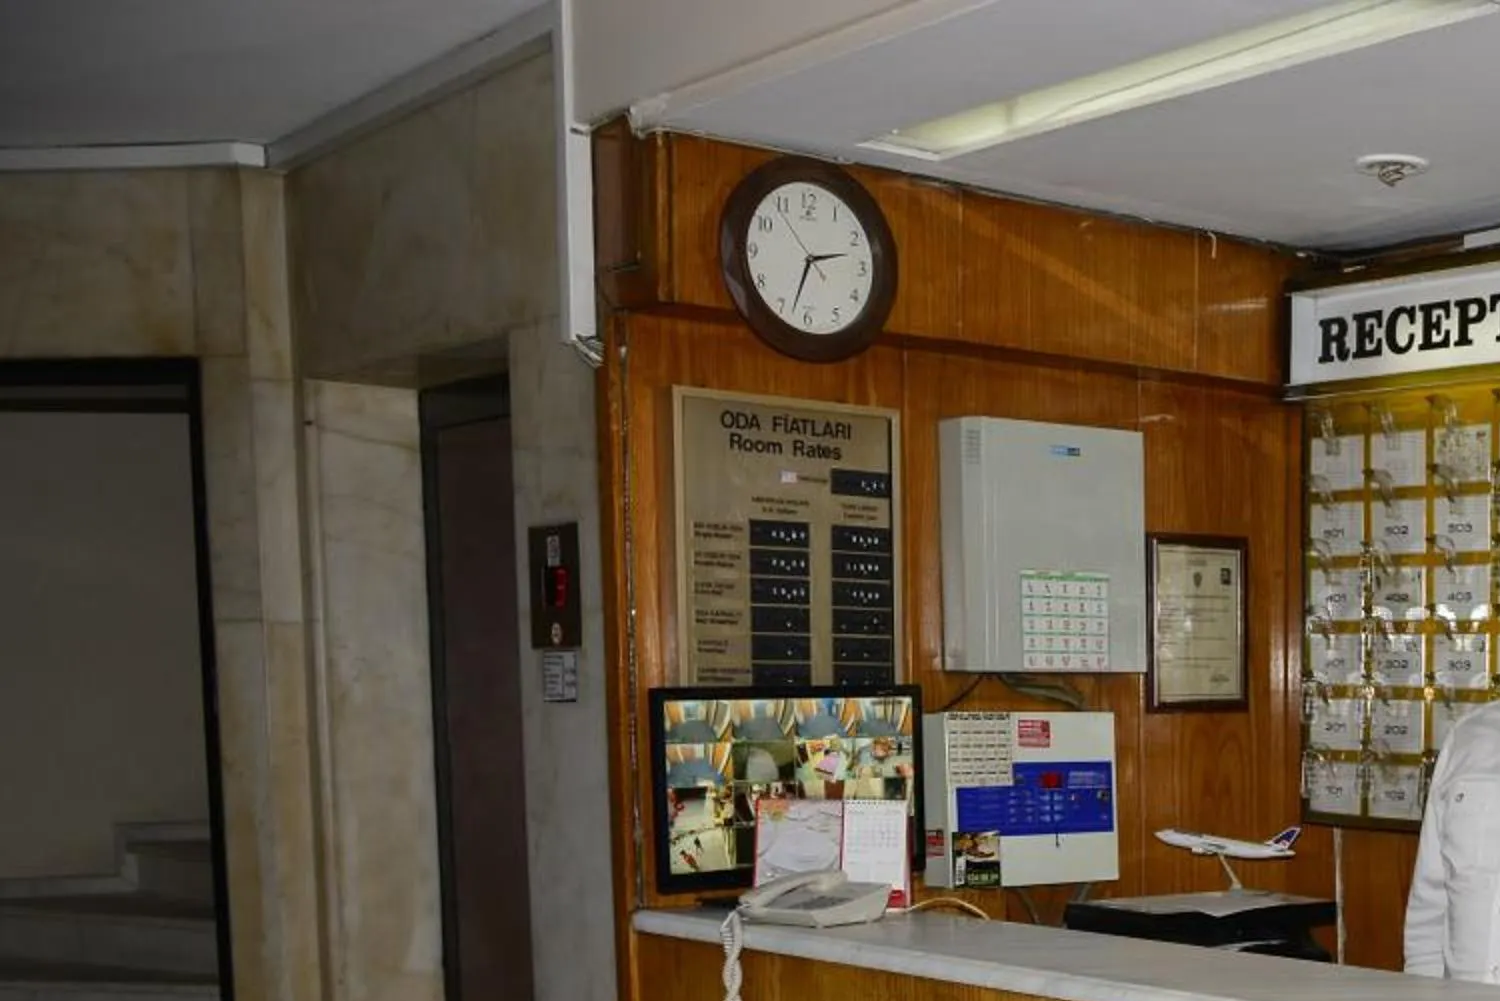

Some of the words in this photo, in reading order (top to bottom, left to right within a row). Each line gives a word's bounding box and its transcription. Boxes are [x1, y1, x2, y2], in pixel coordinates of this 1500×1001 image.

[776, 195, 790, 213] 11
[801, 193, 817, 210] 12
[831, 199, 840, 222] 1
[757, 216, 773, 232] 10
[849, 231, 859, 247] 2
[749, 243, 758, 258] 9
[857, 261, 867, 277] 3
[756, 273, 766, 289] 8
[849, 289, 859, 302] 4
[776, 298, 785, 314] 7
[803, 310, 813, 326] 6
[831, 307, 840, 323] 5
[720, 410, 761, 431] ODA
[729, 432, 783, 456] Room
[793, 440, 843, 461] Rates
